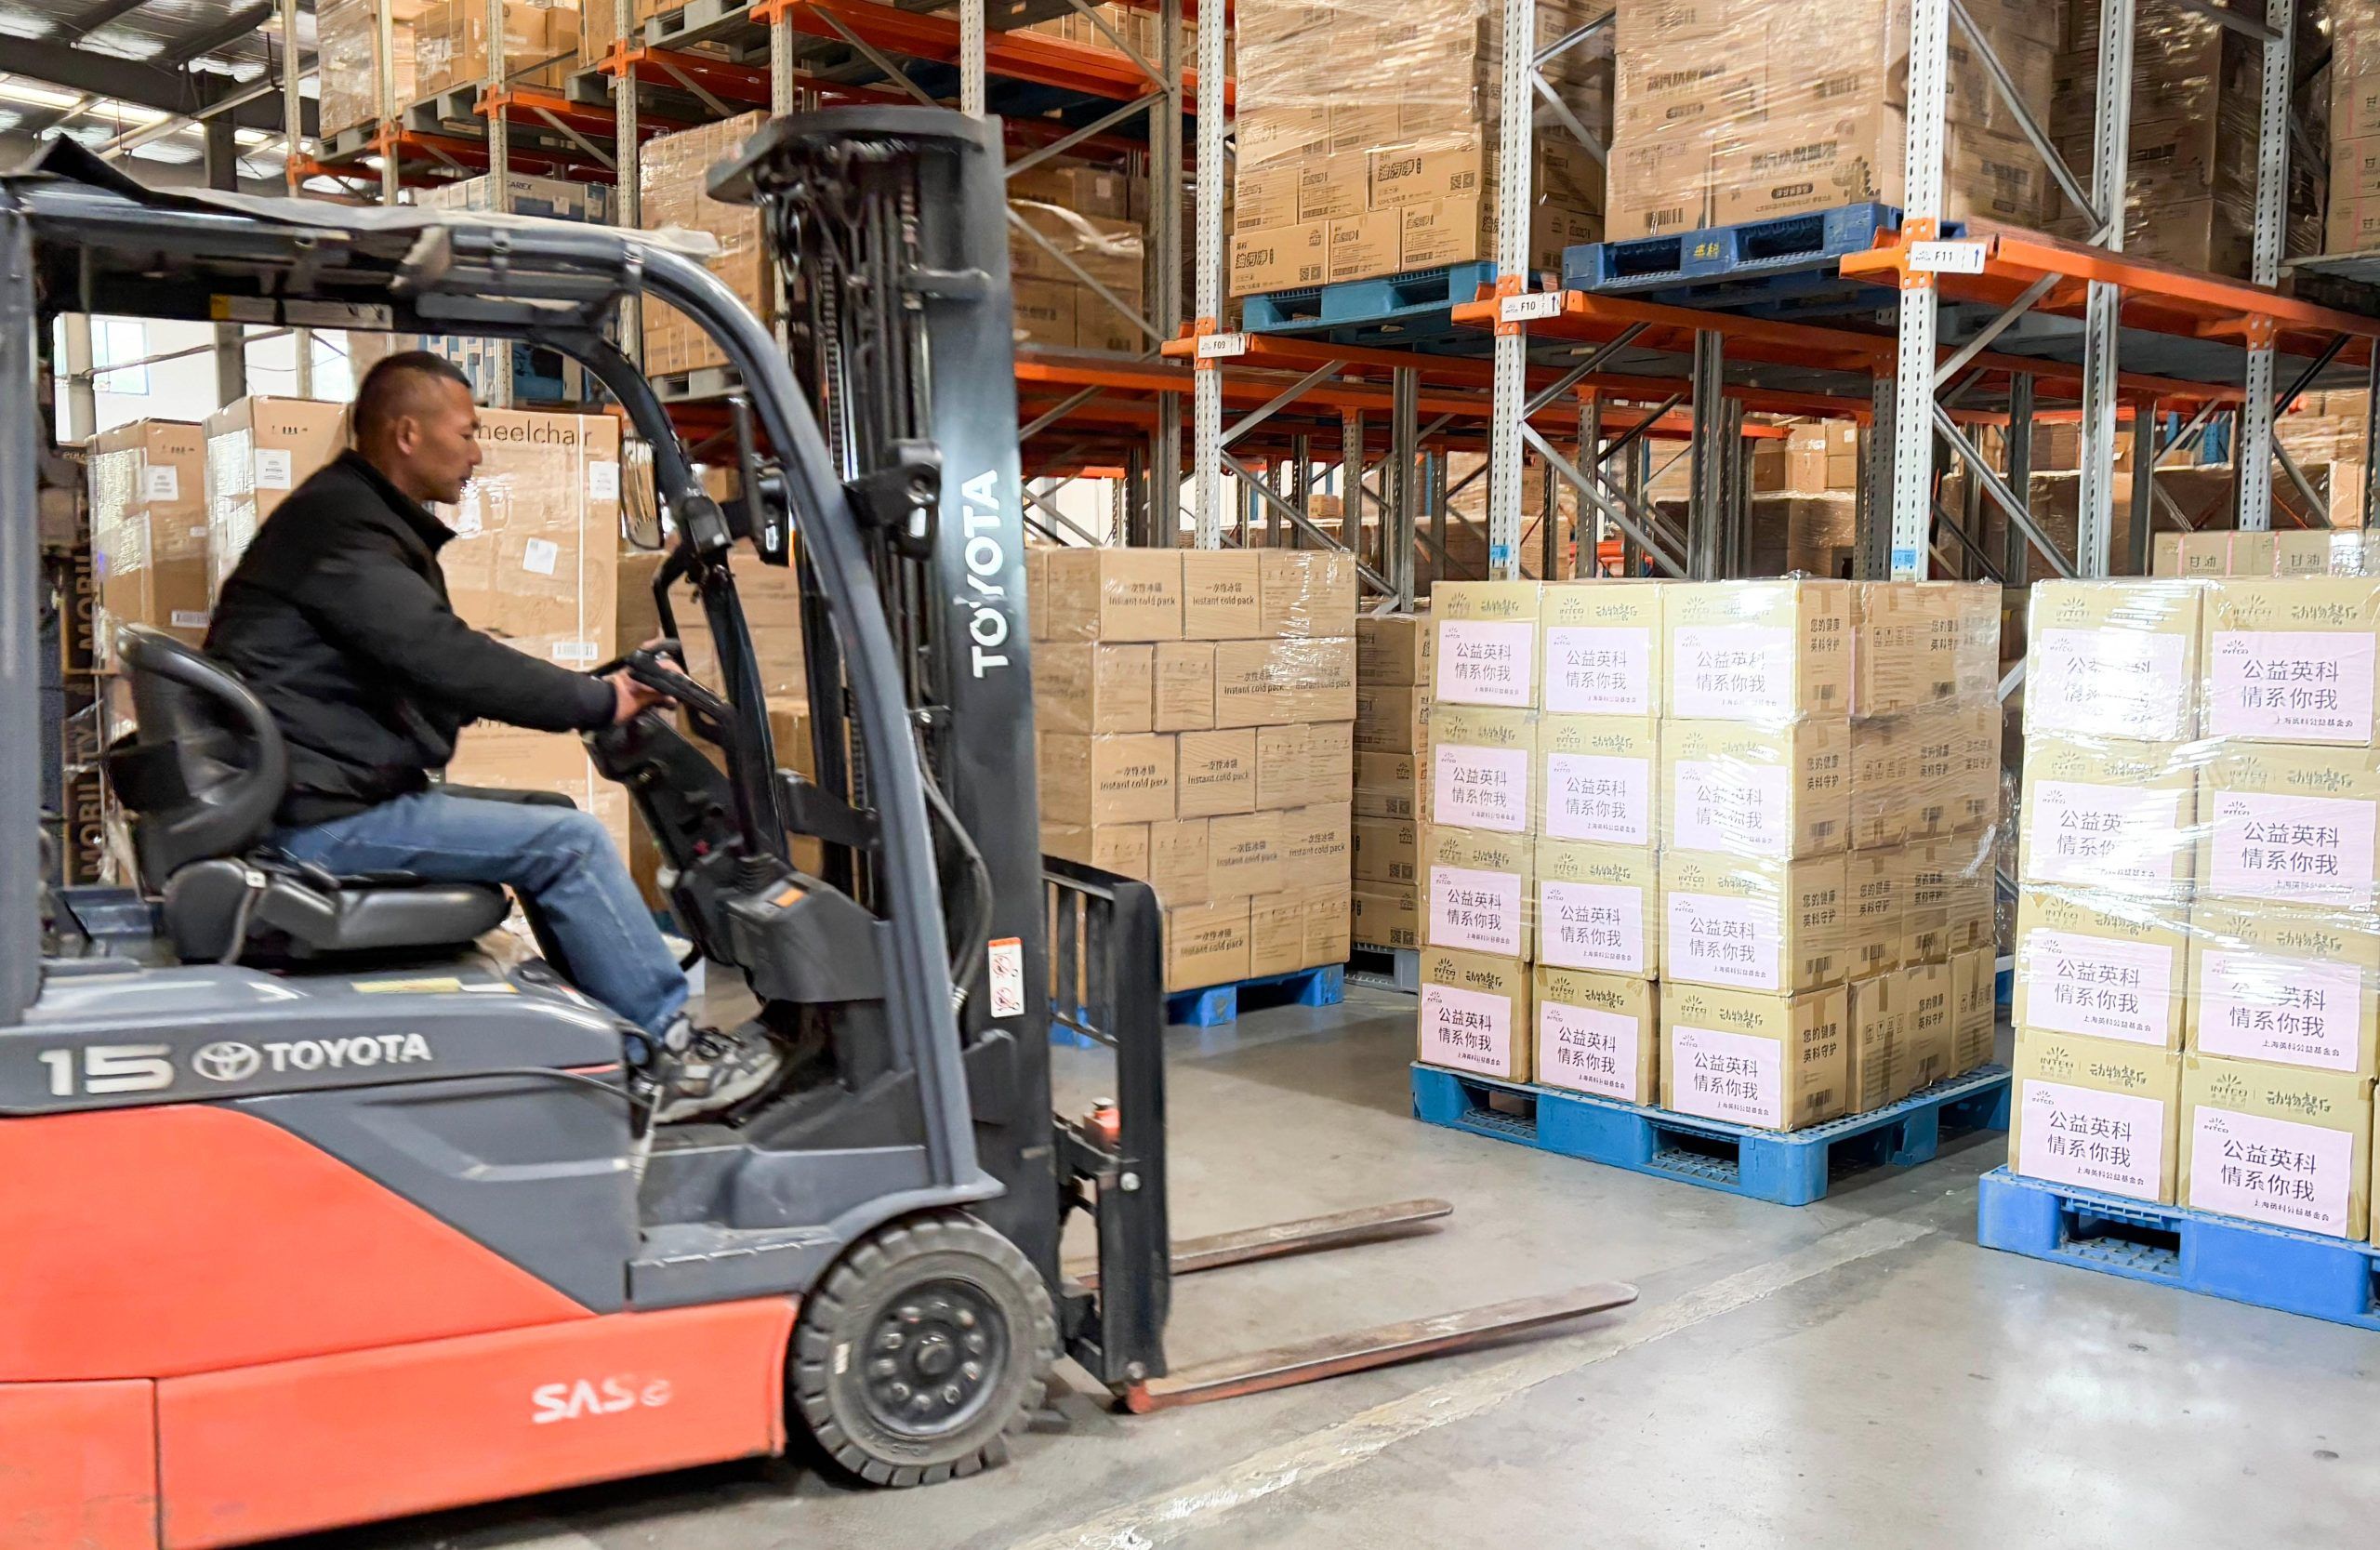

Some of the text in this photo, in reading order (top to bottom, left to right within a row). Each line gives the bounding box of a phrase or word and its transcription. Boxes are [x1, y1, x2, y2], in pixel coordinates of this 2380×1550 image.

[1935, 251, 1952, 261] F11
[1521, 301, 1536, 312] F10
[1213, 340, 1226, 349] F09
[478, 417, 593, 447] heelchar
[961, 469, 1009, 678] TOYOTA
[1456, 643, 1512, 660] 公益英科
[1567, 650, 1627, 669] 公益英科
[1697, 651, 1765, 669] 公益英科
[1455, 663, 1511, 682] 情系你我
[1566, 671, 1627, 690] 情系你我
[2242, 659, 2339, 682] 公益英科
[1697, 673, 1765, 693] 情系你我
[2241, 685, 2338, 710] 情系你我
[1453, 767, 1507, 787] 公益英科
[1567, 777, 1626, 797] 公益英科
[1452, 788, 1507, 808] 情系你我
[1566, 798, 1626, 819] 情系你我
[2060, 809, 2136, 834] 公益英
[2243, 821, 2339, 849] 公益英科
[2241, 847, 2338, 876] 情系你我
[1448, 889, 1501, 911] 公益英科
[1448, 908, 1501, 931] 情系你我
[1561, 905, 1621, 925] 公益英科
[1561, 926, 1622, 947] 情系你我
[1689, 917, 1756, 940] 公益英科
[1689, 938, 1755, 962] 情系你我
[2057, 959, 2141, 988] 公益英科
[2055, 983, 2139, 1014] 情系你我
[2231, 982, 2326, 1011] 英科
[1439, 1007, 1492, 1031] 公益英科
[2229, 1006, 2324, 1039] 情系你我
[1439, 1027, 1492, 1053] 情系你我
[1558, 1026, 1616, 1053] 公益英科
[1803, 1023, 1837, 1043] 您的健康
[264, 1033, 433, 1072] TOYOTA
[1557, 1046, 1616, 1075] 情系你我
[1803, 1042, 1837, 1064] 英科守护
[38, 1044, 175, 1095] 15
[1694, 1052, 1758, 1078] 公益英科
[2090, 1063, 2147, 1088] 动物餐厅
[1694, 1072, 1758, 1101] 情系你我
[2266, 1091, 2332, 1116] 动物餐厅
[2050, 1110, 2132, 1142] 公益英科
[2047, 1133, 2131, 1168] 情系你我
[2224, 1139, 2317, 1175] 公益英科
[2077, 1166, 2145, 1186] 上海英科公益基金会
[2221, 1164, 2315, 1202] 情系你我
[2254, 1199, 2330, 1222] 上海英科公益基金会
